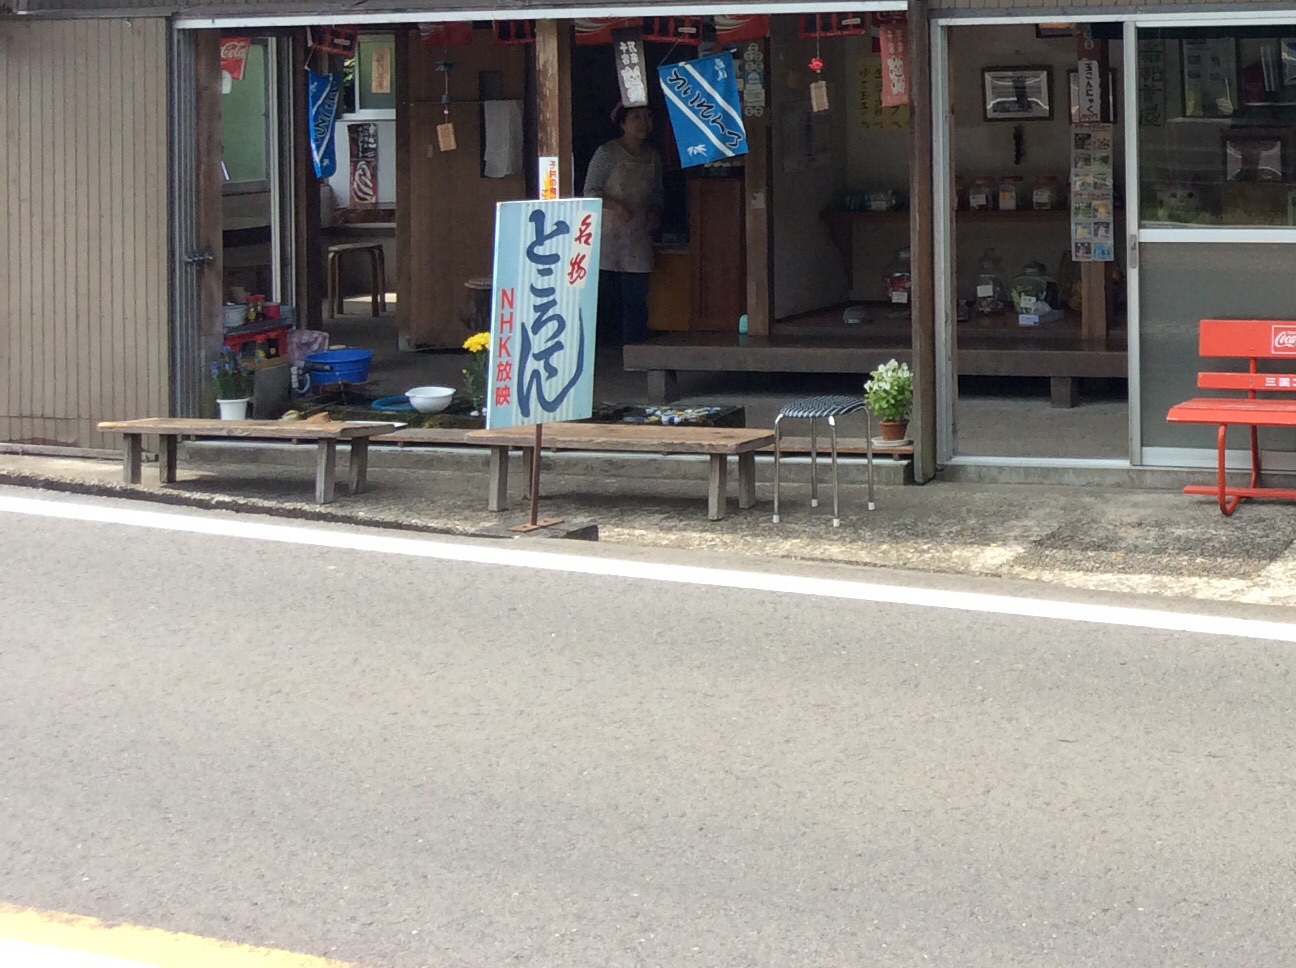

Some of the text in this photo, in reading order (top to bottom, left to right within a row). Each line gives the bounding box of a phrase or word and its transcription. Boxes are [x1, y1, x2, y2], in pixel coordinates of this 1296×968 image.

[567, 214, 593, 285] 名物
[494, 287, 516, 407] NHK放映
[517, 209, 586, 418] ところてん
